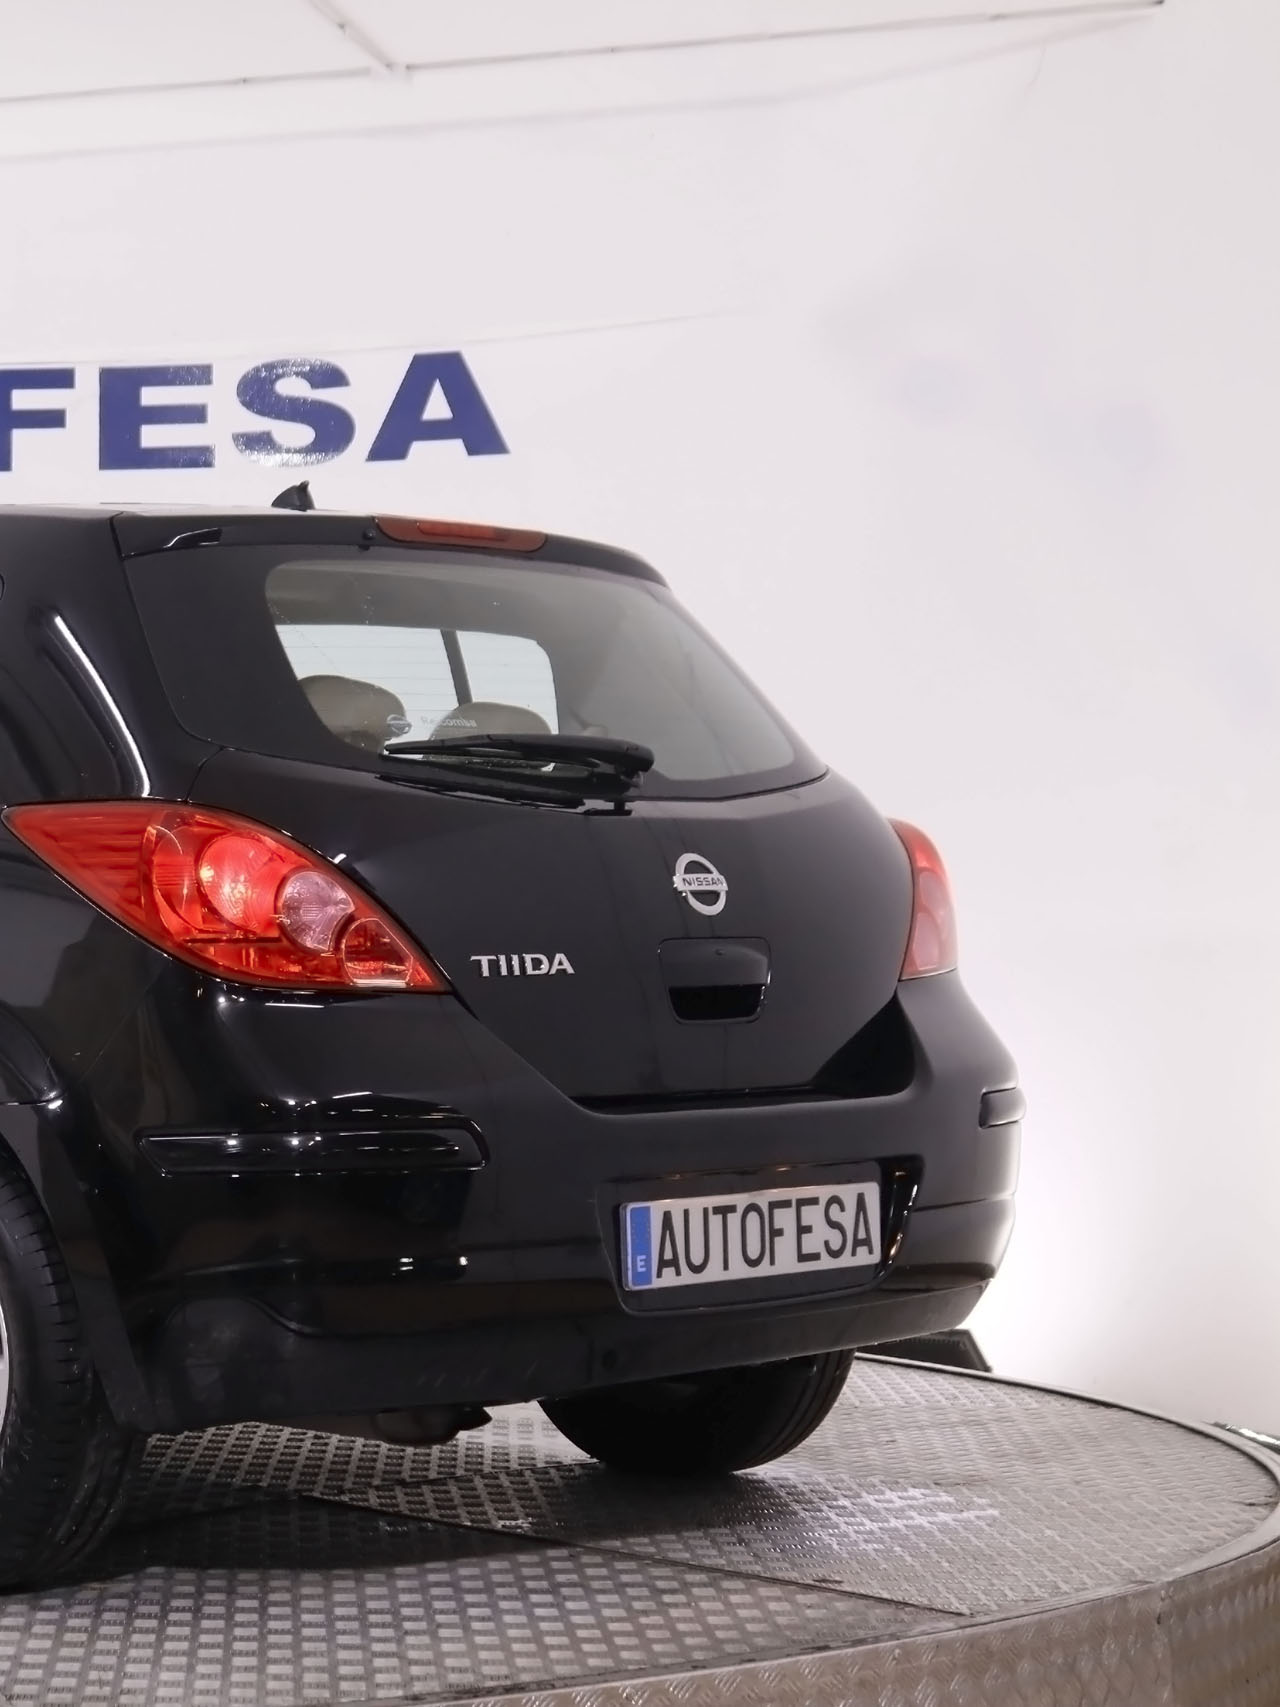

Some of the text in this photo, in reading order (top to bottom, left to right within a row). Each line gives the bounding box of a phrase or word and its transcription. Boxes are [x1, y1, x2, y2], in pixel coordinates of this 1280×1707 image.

[682, 876, 725, 887] NISSAN
[470, 953, 575, 977] TIIDA
[636, 1192, 874, 1279] E AUTOFESA
